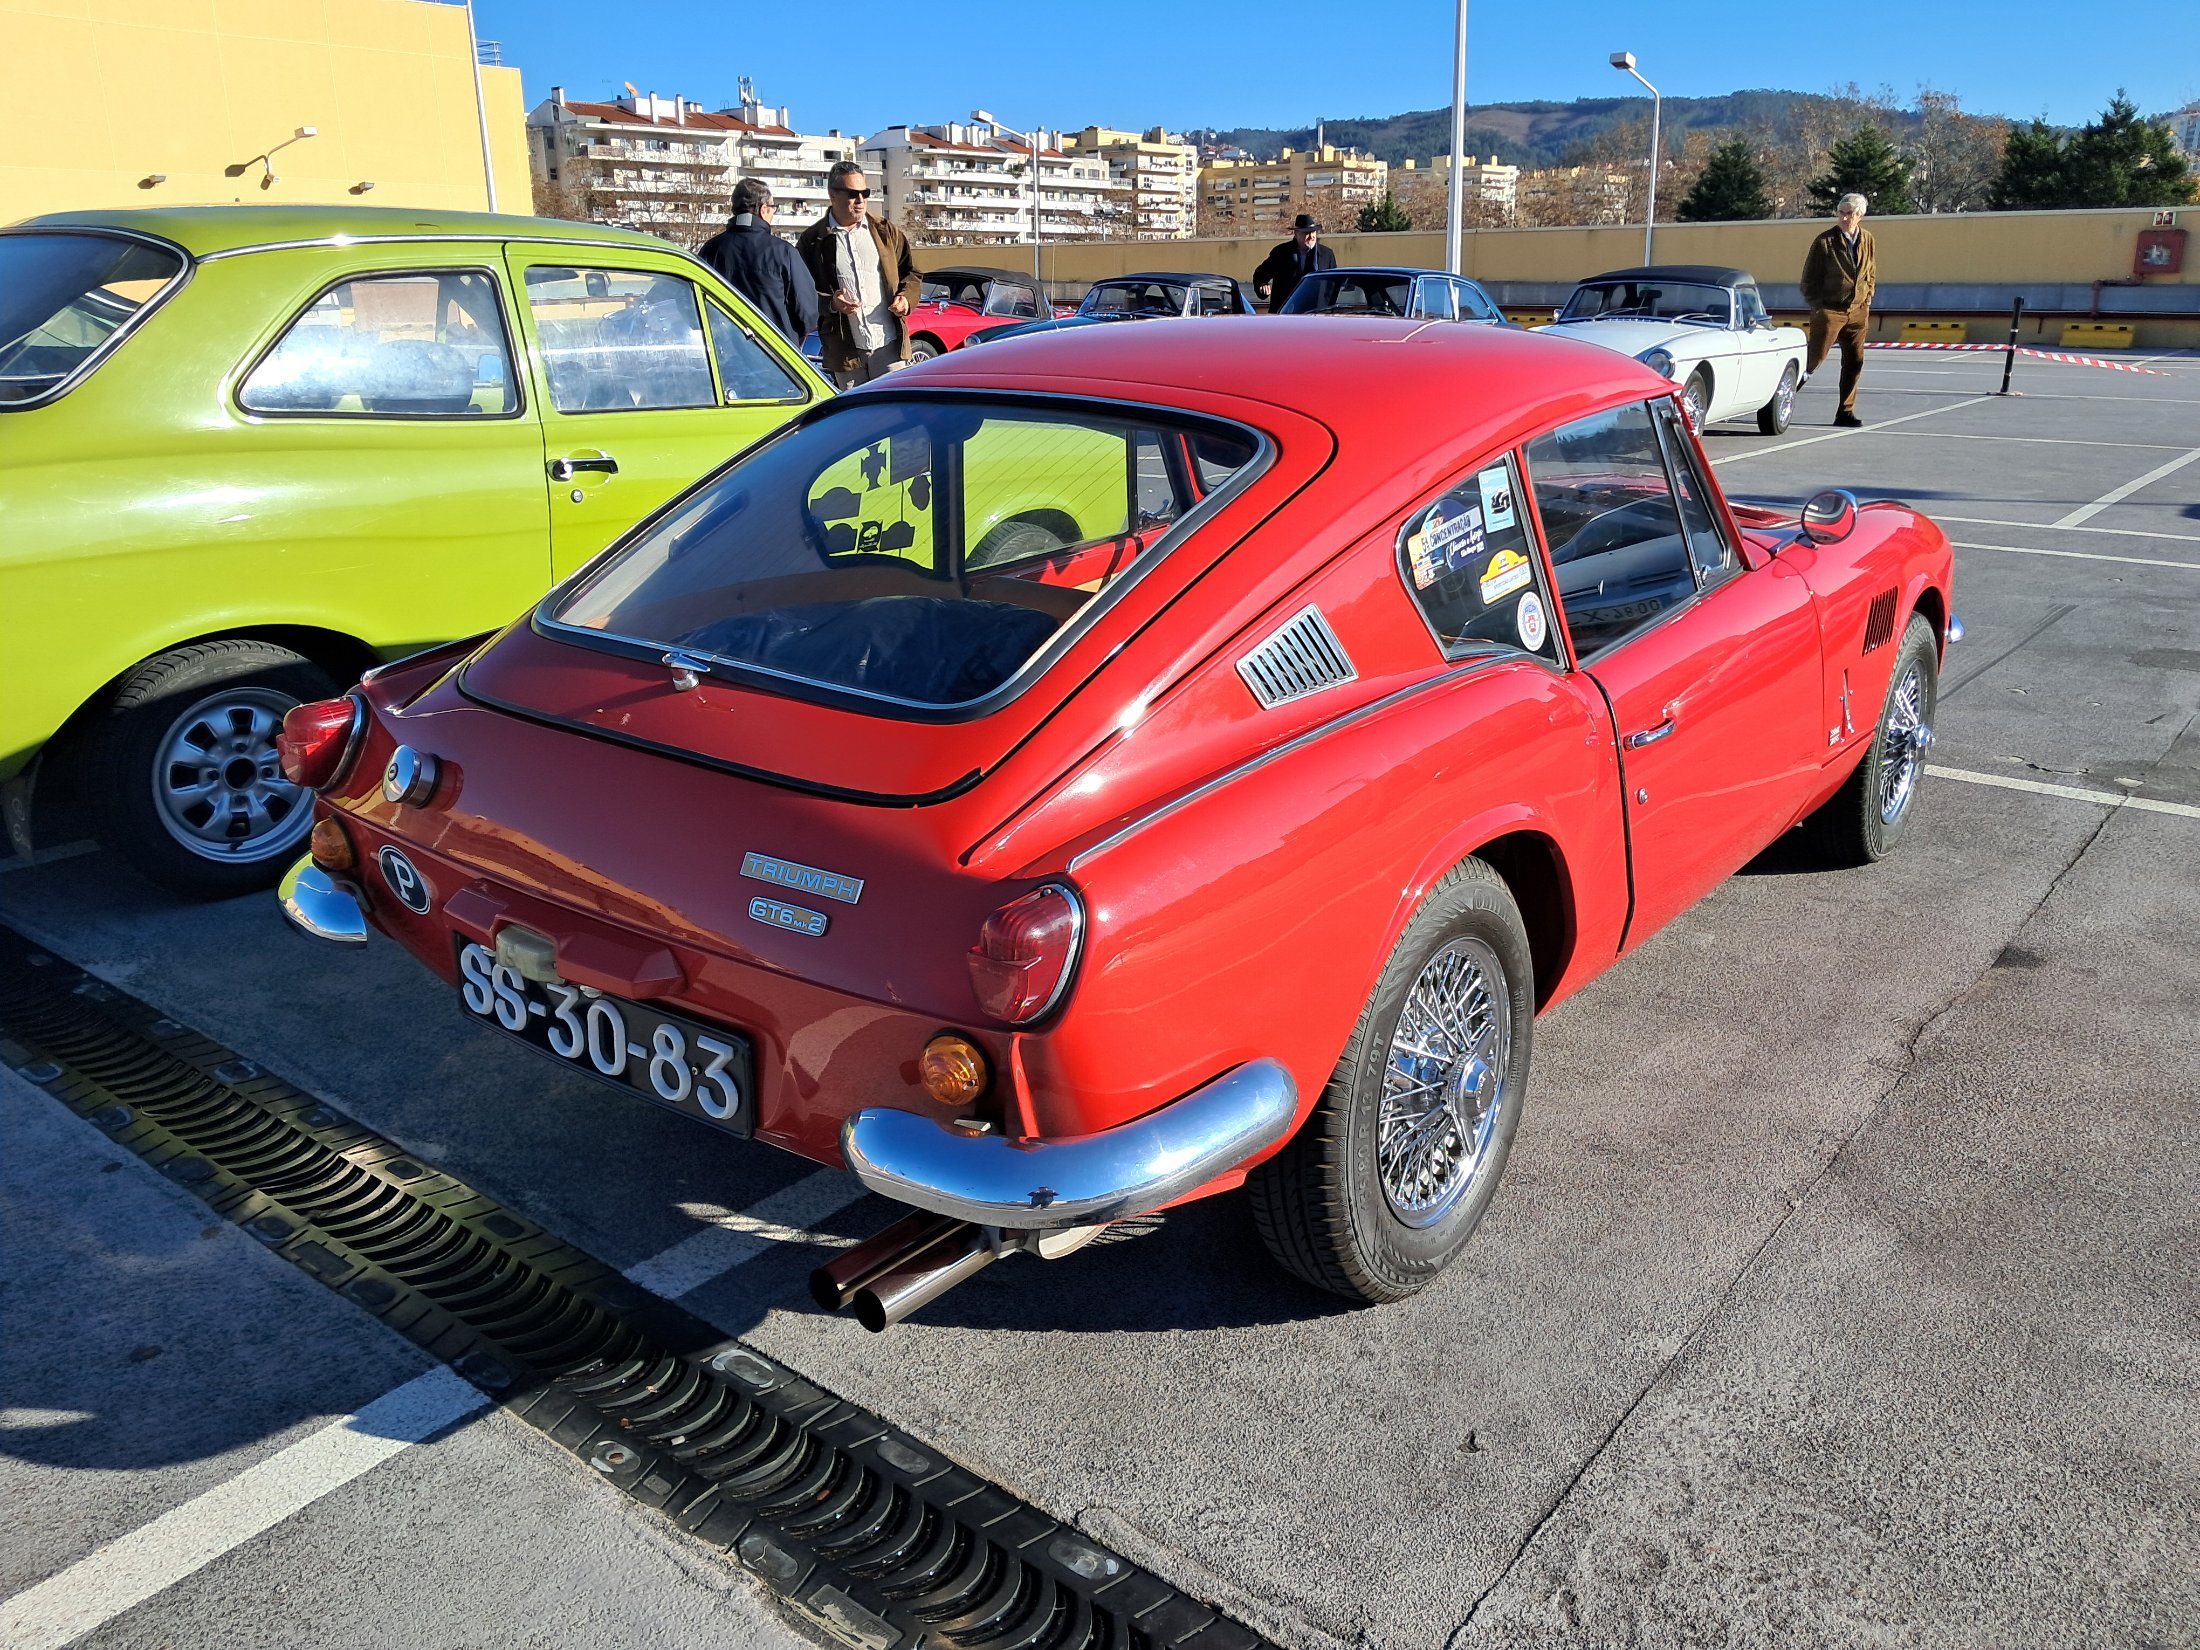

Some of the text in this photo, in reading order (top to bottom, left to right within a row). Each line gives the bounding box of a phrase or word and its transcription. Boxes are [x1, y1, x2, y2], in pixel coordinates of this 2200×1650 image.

[390, 854, 414, 901] P
[749, 857, 855, 898] TRIUMPH
[460, 943, 739, 1120] SS-30-83
[1366, 1032, 1385, 1077] 79T
